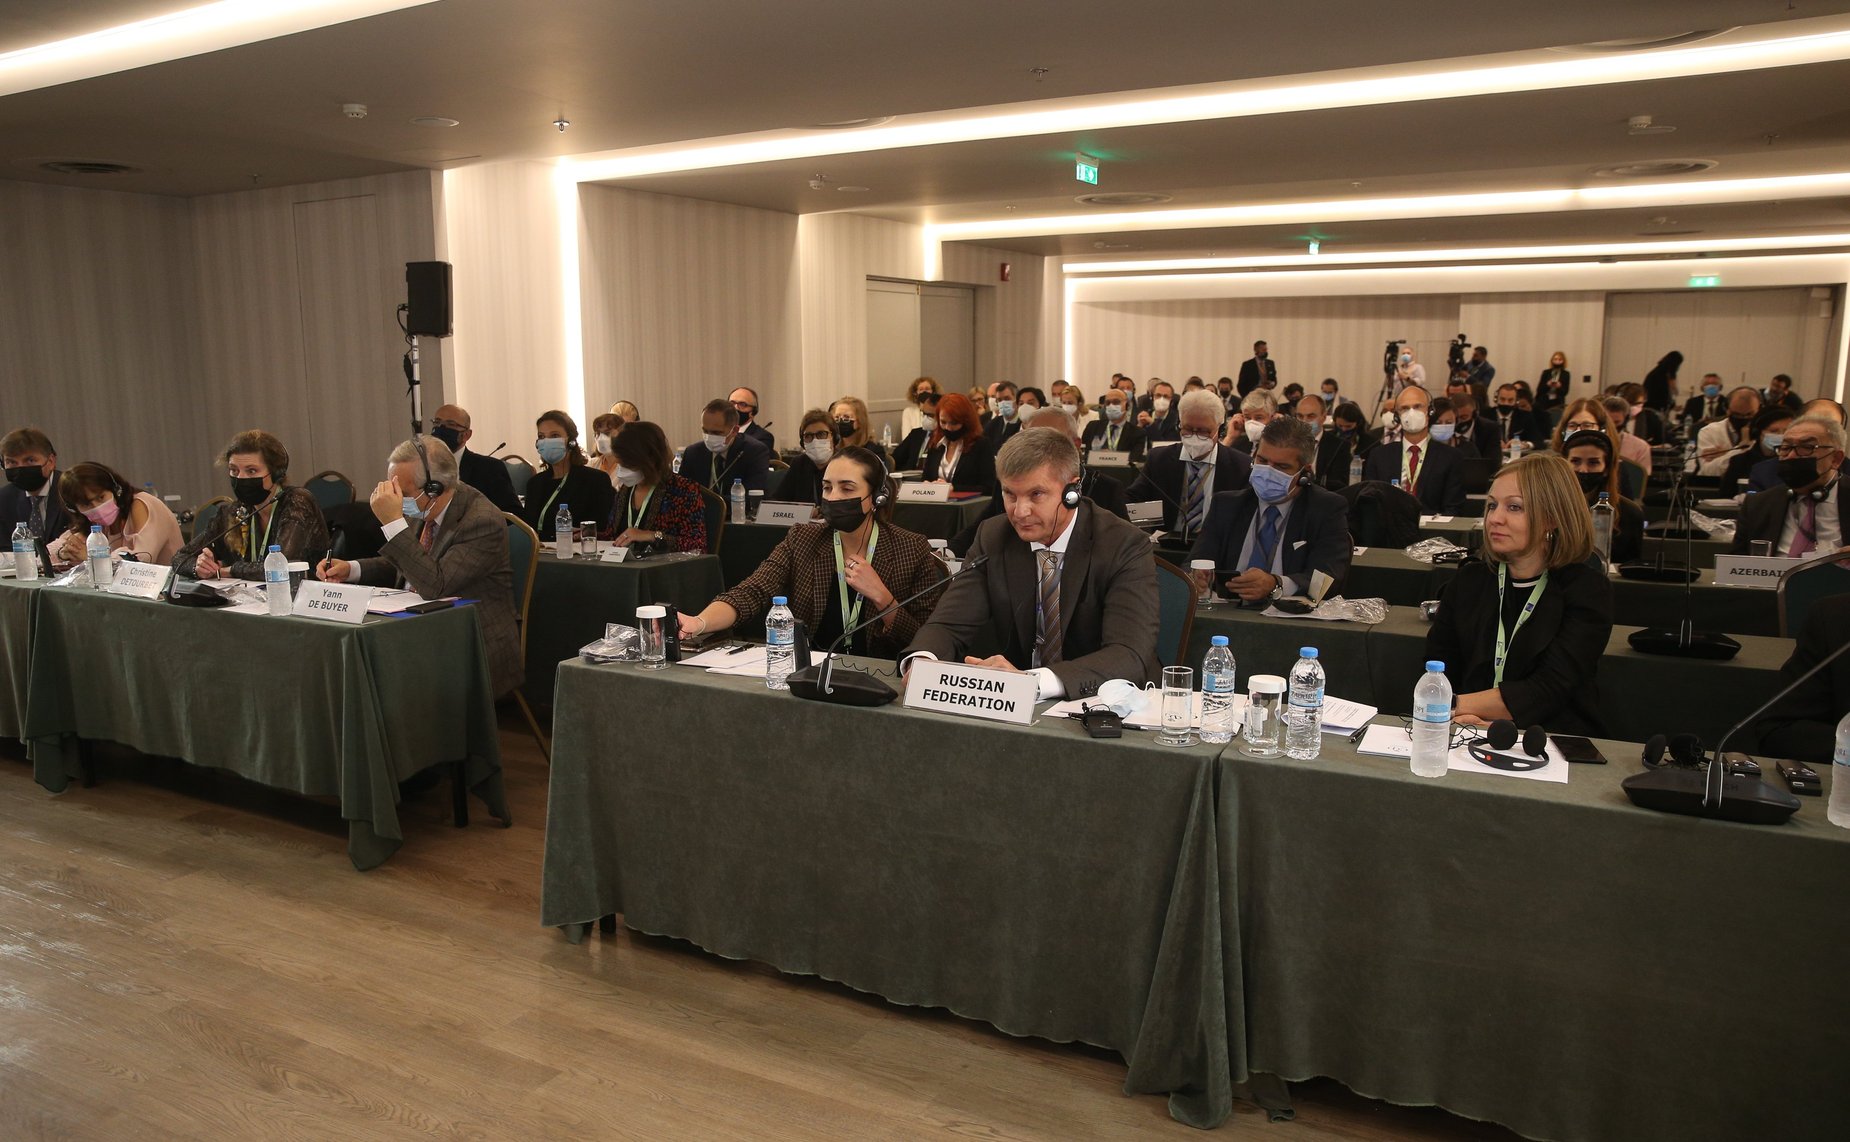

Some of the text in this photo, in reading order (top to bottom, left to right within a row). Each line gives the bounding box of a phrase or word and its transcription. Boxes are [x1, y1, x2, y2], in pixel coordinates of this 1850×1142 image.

[130, 567, 157, 578] Christine
[323, 589, 343, 599] Yann
[308, 600, 349, 612] DE BUYER
[939, 673, 1005, 693] RUSSIAN
[922, 688, 1016, 713] FEDERATION
